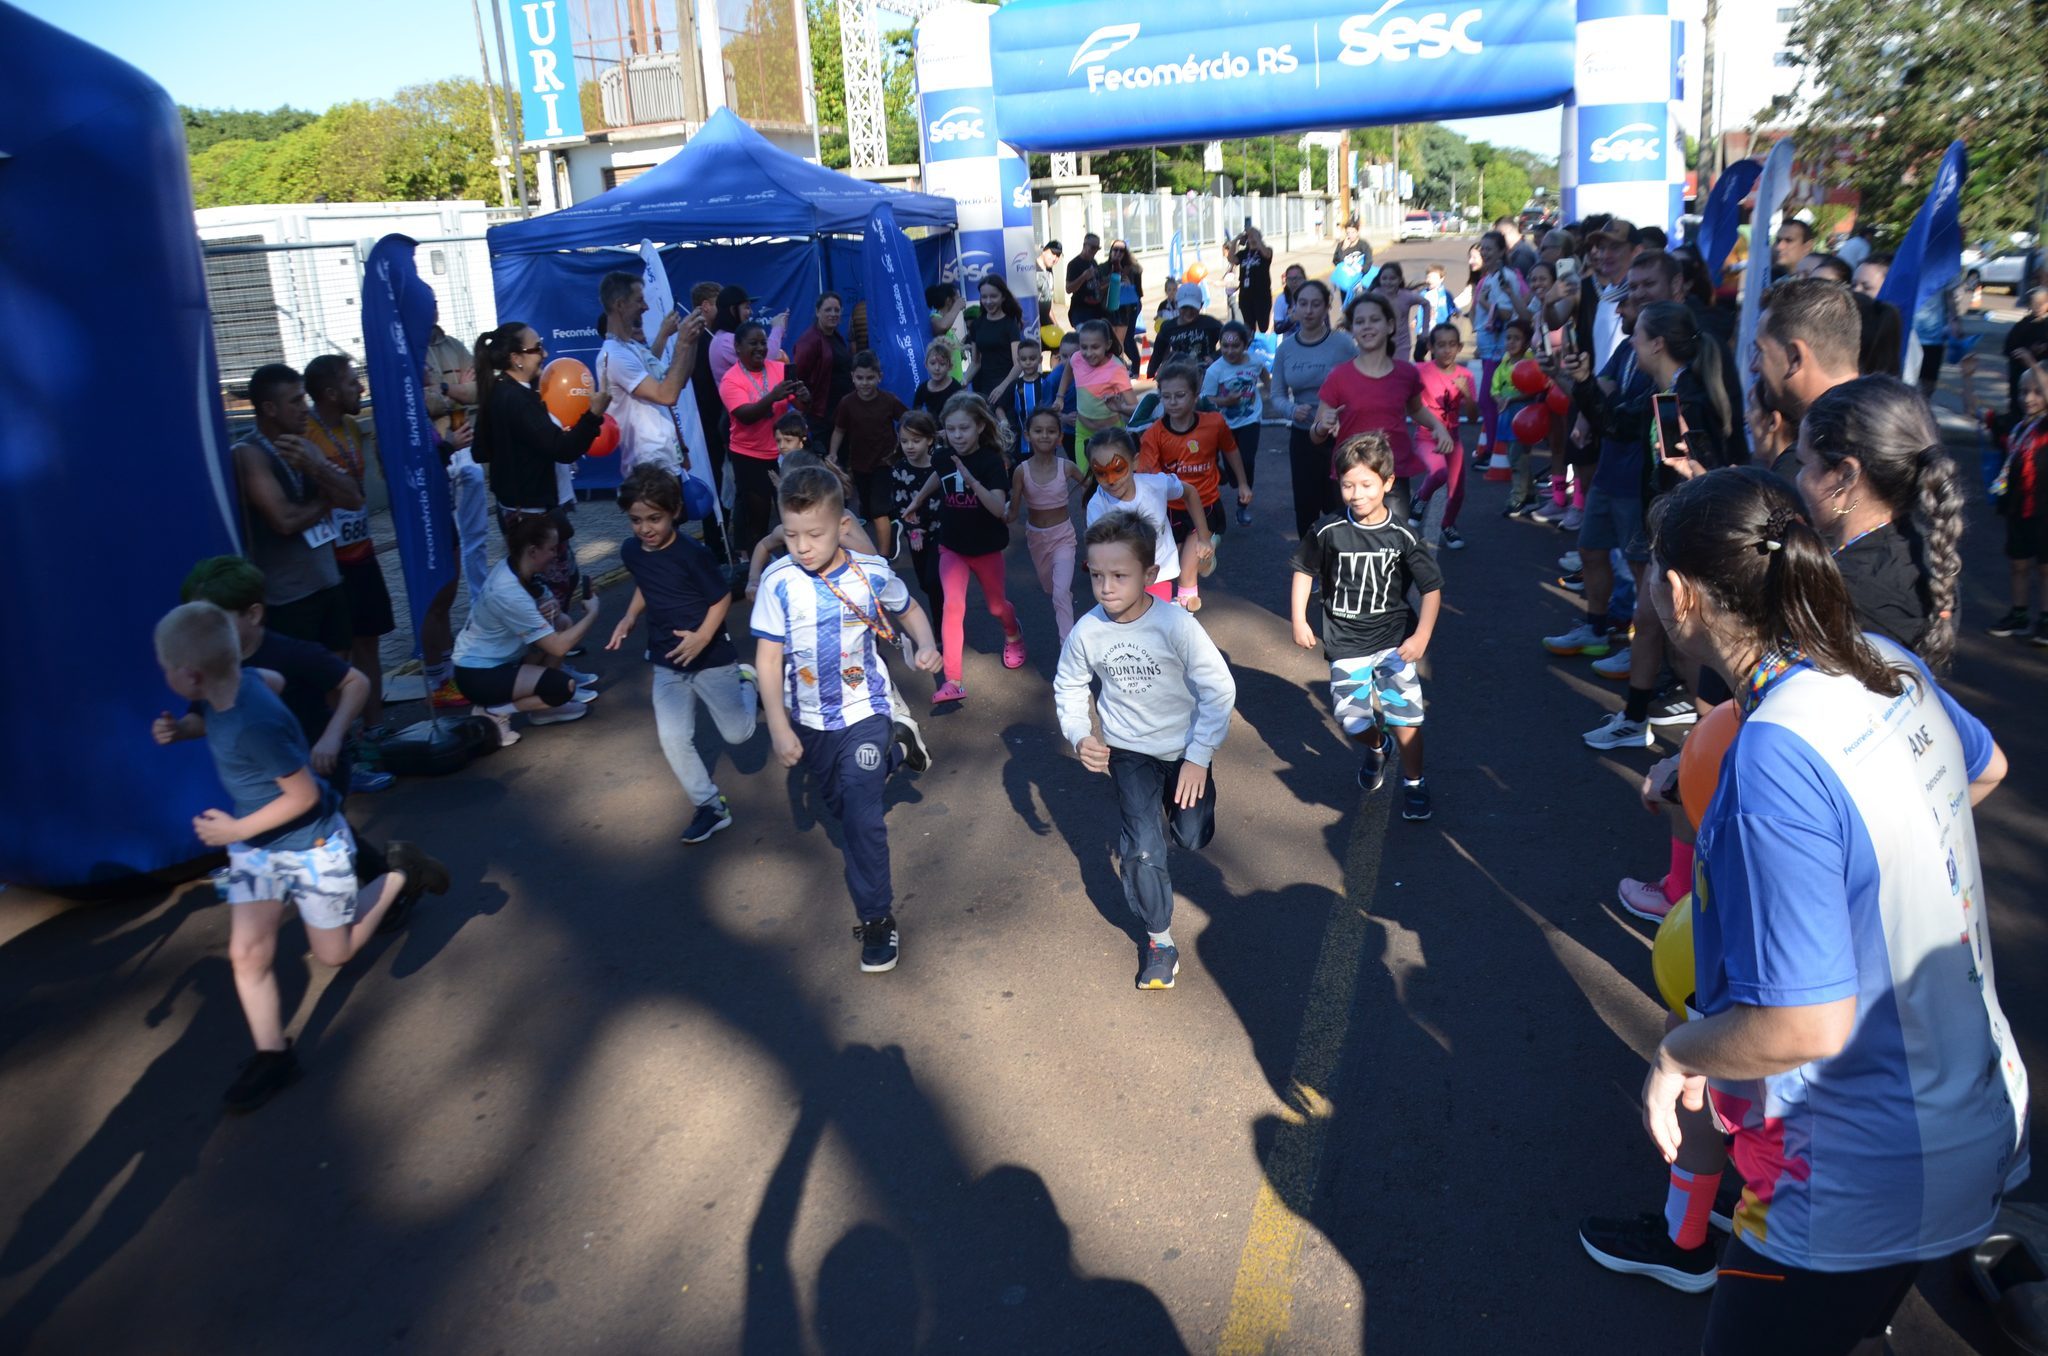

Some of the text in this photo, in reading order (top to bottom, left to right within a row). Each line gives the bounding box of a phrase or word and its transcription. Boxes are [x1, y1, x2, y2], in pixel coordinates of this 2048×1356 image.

[1337, 8, 1483, 66] Sesc
[521, 1, 564, 137] URI
[1087, 44, 1299, 93] Fecomércio RS
[929, 118, 985, 143] Sesc
[552, 326, 599, 339] Fecomér
[907, 348, 921, 393] comércio
[404, 376, 423, 447] Sindicatos
[415, 466, 427, 487] RS
[418, 489, 437, 571] Fecomércio
[1333, 552, 1401, 614] NY
[1127, 643, 1139, 651] ALL
[1102, 663, 1162, 677] MOUNTAINS
[1118, 683, 1153, 694] REGON
